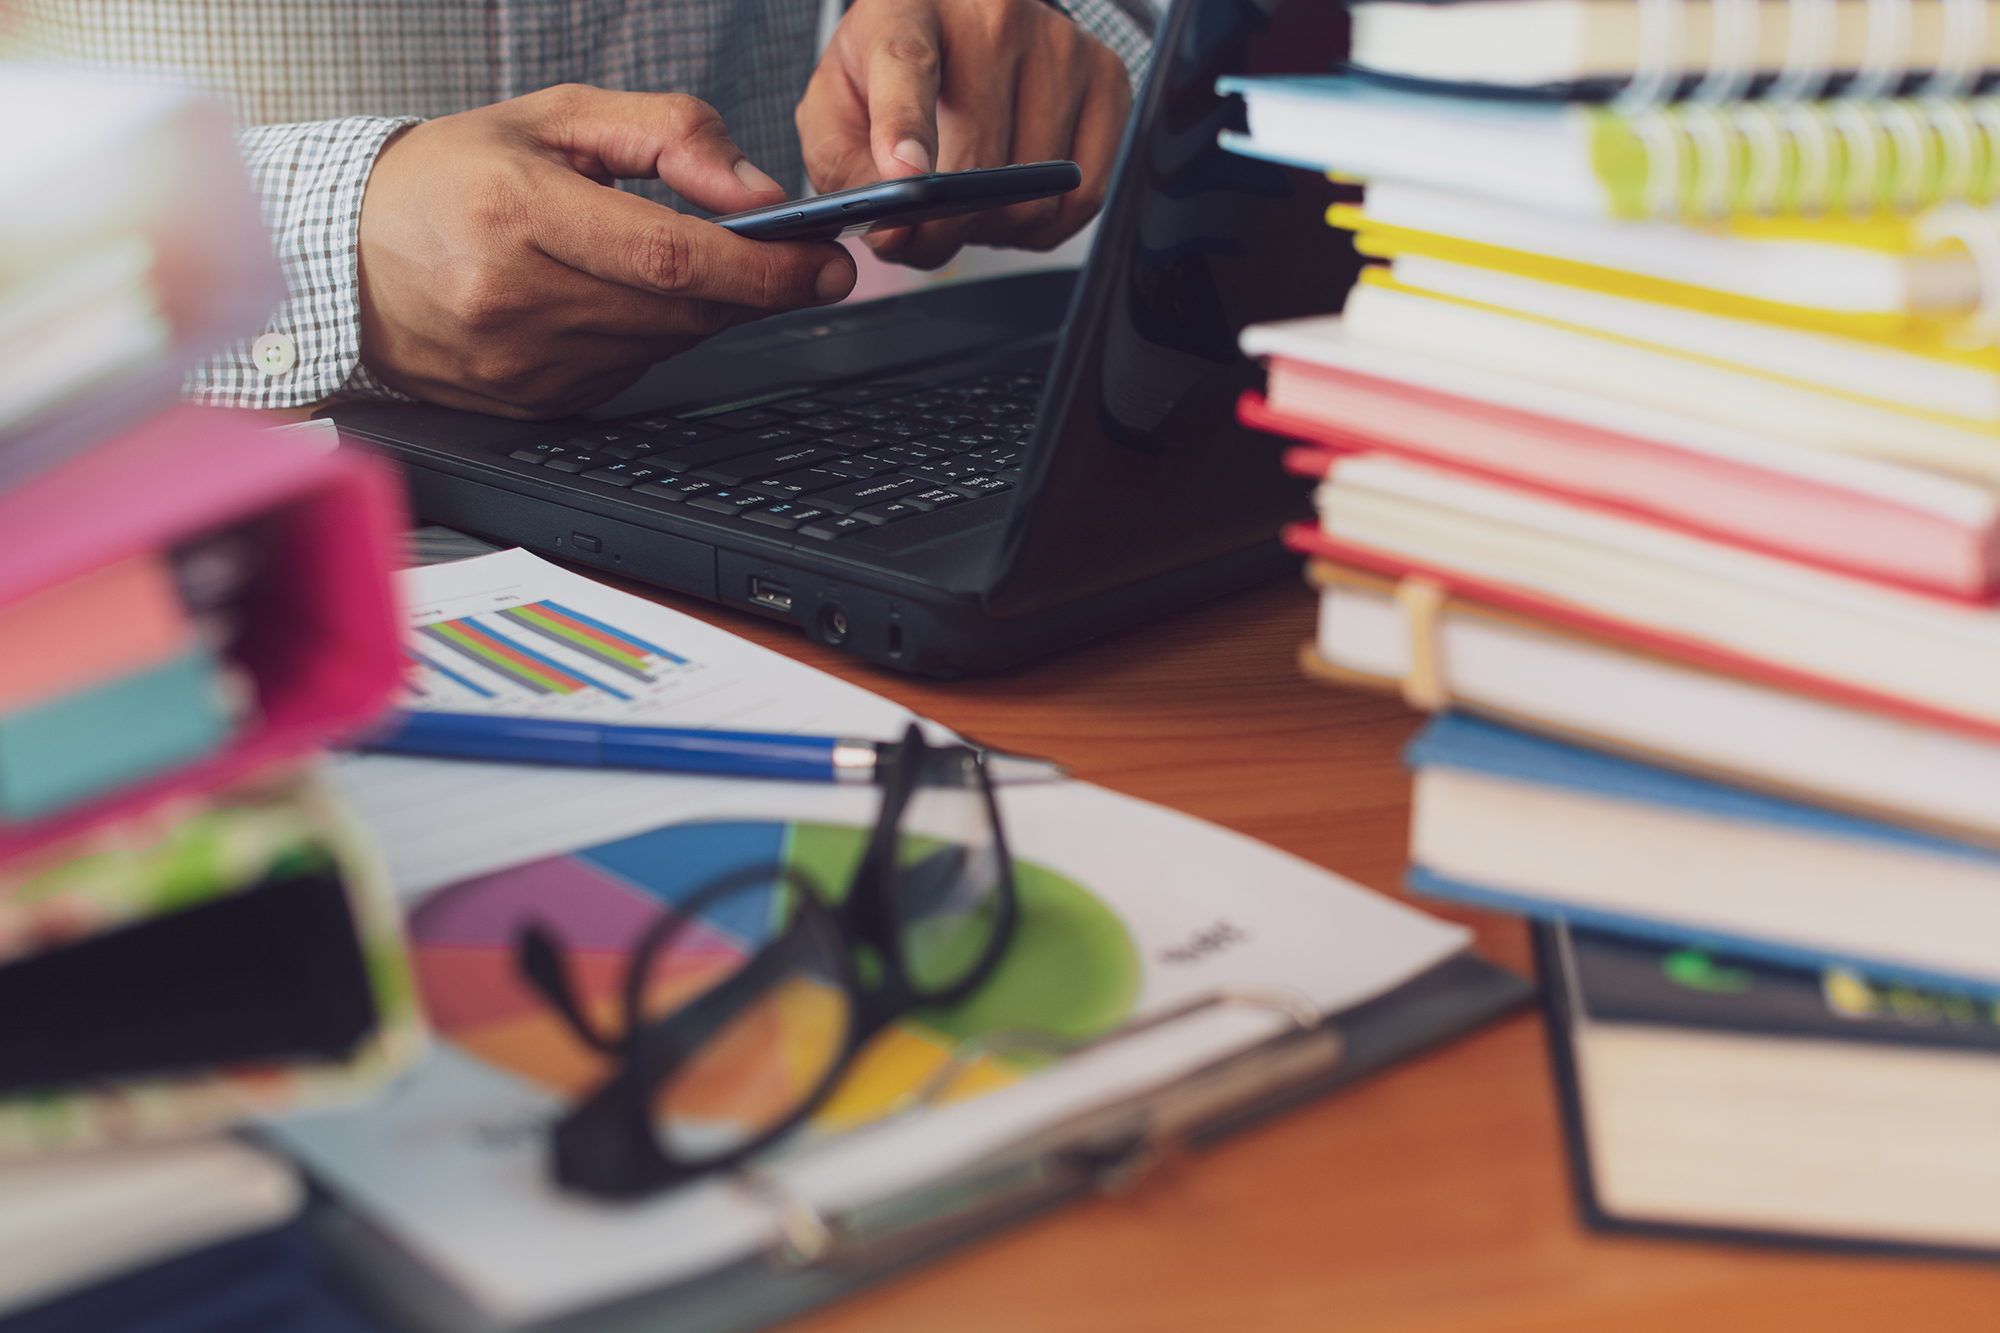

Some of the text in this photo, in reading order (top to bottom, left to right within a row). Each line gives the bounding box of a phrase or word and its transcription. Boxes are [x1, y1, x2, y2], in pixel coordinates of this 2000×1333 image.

[775, 453, 798, 462] Enter
[632, 469, 652, 477] End
[855, 483, 898, 497] Backspace
[917, 490, 943, 498] Break
[933, 493, 959, 502] Pause
[793, 509, 821, 519] Home
